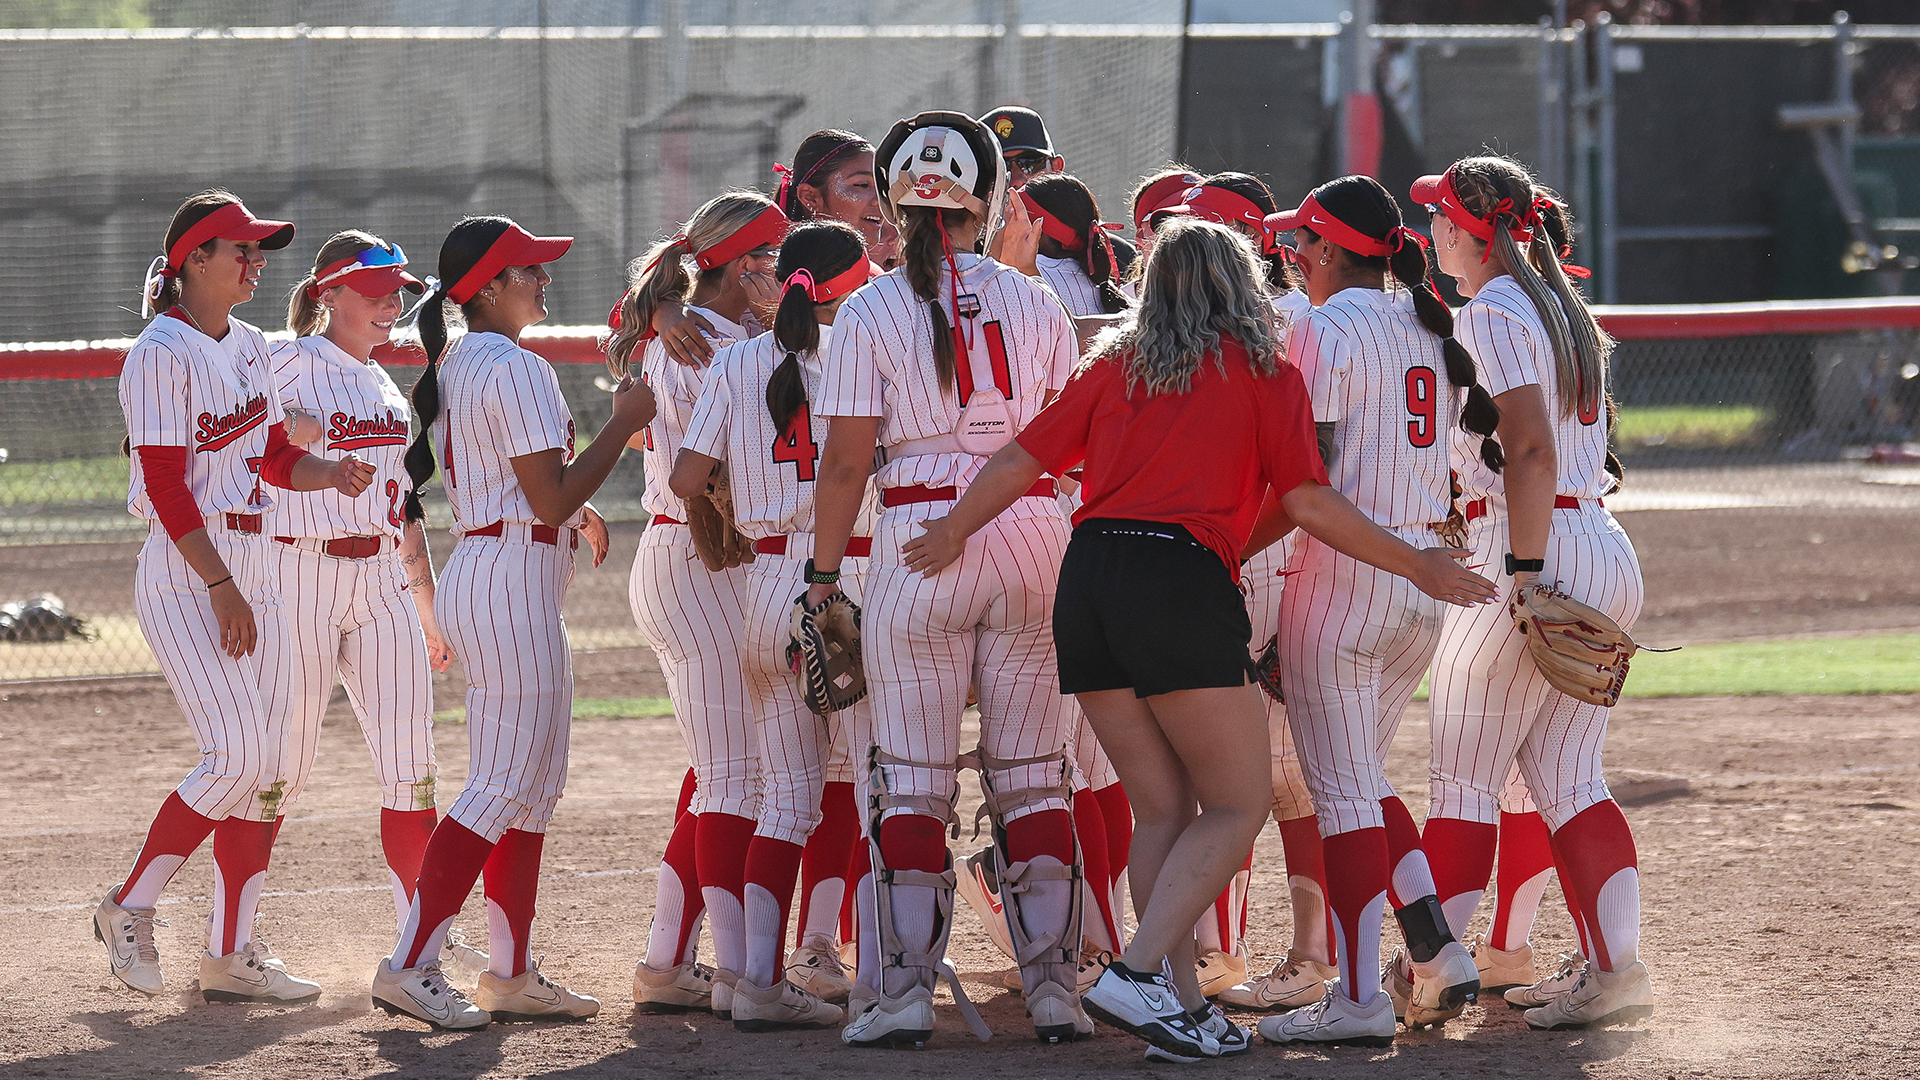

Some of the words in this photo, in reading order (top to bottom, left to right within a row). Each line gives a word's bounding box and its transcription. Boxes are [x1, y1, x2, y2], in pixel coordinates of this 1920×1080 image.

[195, 391, 267, 443] Stanislaus
[772, 400, 818, 482] 4
[1405, 366, 1436, 449] 9
